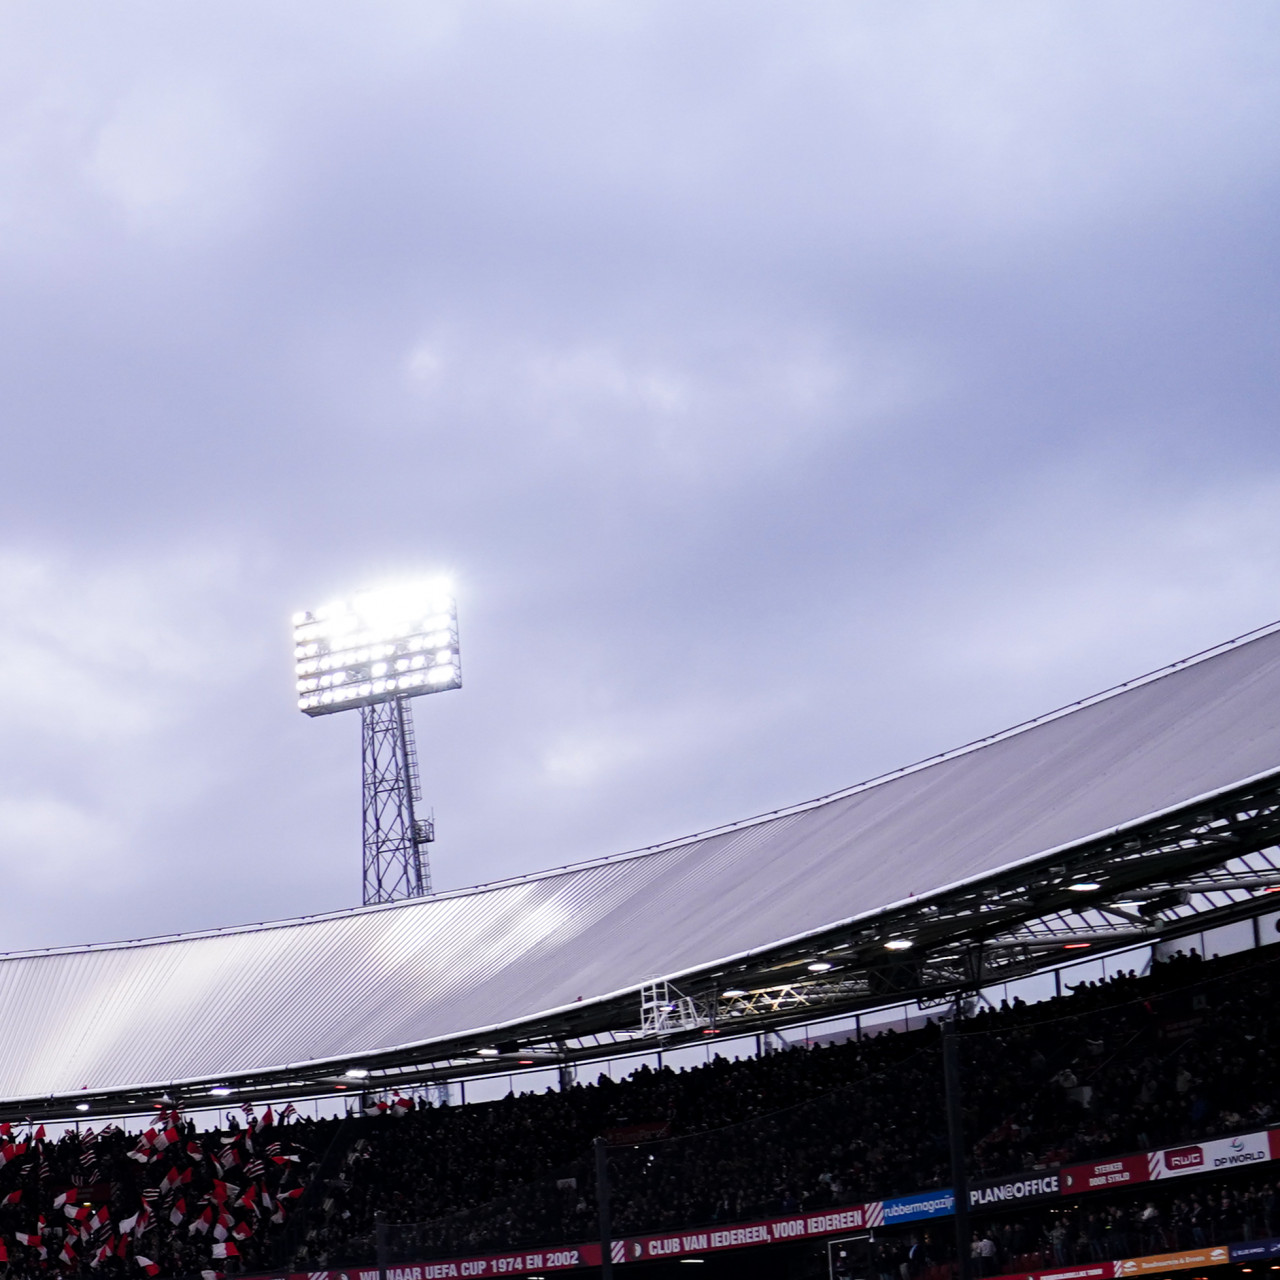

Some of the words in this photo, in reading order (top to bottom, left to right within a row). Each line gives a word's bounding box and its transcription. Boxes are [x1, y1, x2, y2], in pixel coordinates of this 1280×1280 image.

[1170, 1153, 1201, 1167] RWG
[1214, 1158, 1228, 1167] DP
[1229, 1151, 1266, 1164] WORLD
[970, 1176, 1059, 1206] PLAN@OFFICE
[648, 1238, 681, 1256] CLUB
[682, 1234, 708, 1250] VAN
[710, 1226, 770, 1244] IEDEREEN,
[771, 1221, 804, 1238] VOOR
[807, 1211, 862, 1233] IEDEREEN
[425, 1262, 459, 1280] UEFA
[461, 1259, 487, 1277] CUP
[490, 1255, 523, 1274] 1974
[526, 1253, 544, 1269] EN
[547, 1249, 579, 1267] 2002
